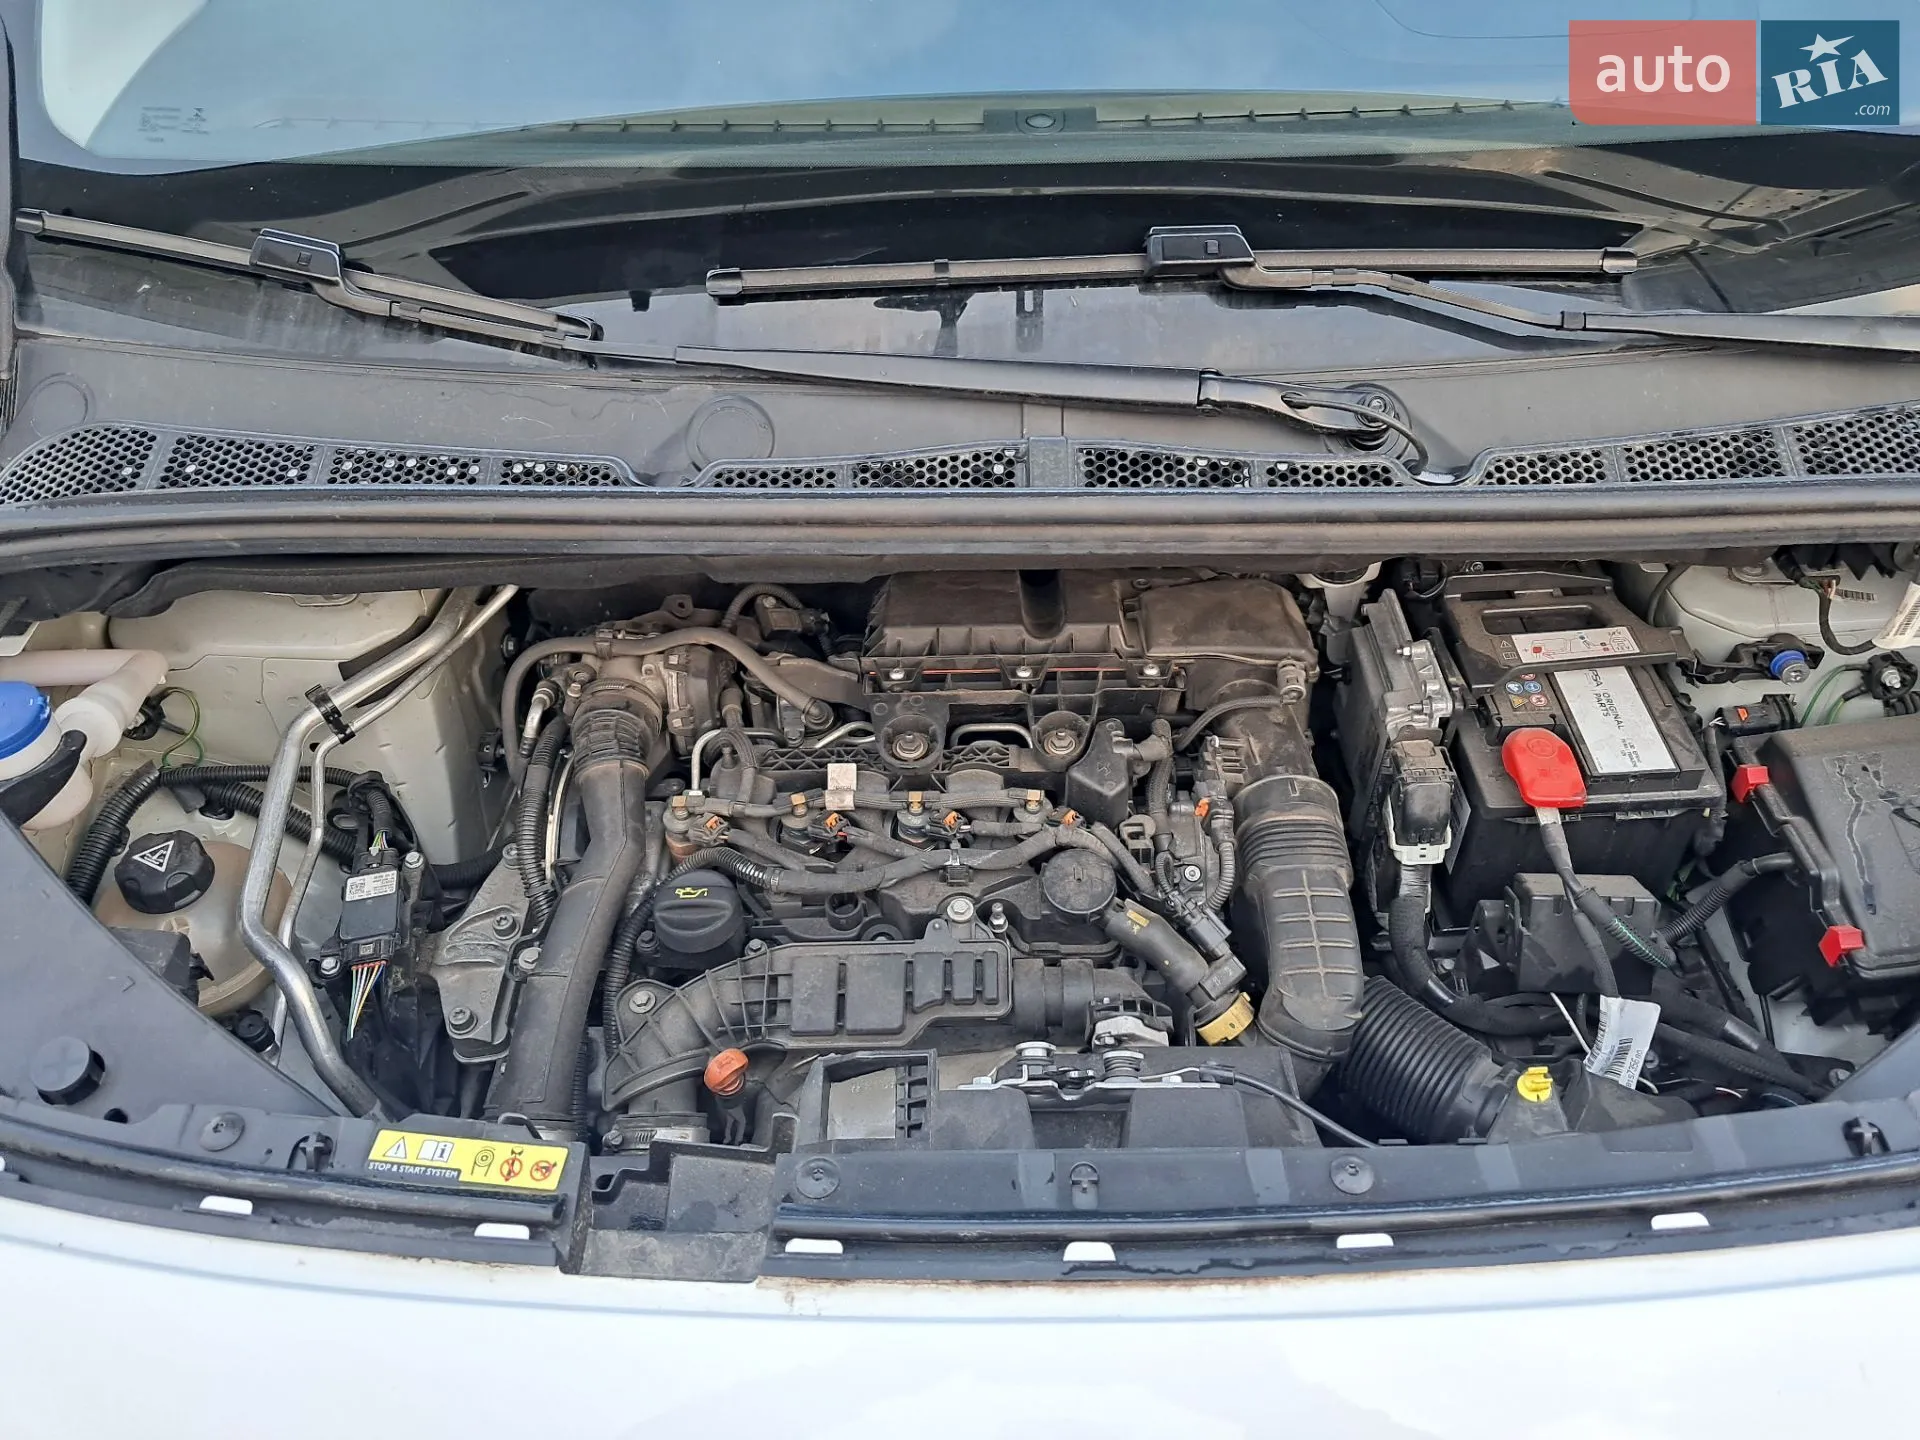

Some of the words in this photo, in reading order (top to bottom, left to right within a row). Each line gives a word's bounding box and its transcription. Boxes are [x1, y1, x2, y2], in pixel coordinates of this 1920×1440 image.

[1588, 669, 1603, 687] PSA
[1602, 692, 1624, 730] ORIGINAL
[1593, 692, 1611, 717] PARTS
[368, 1162, 391, 1170] STOP
[399, 1165, 425, 1174] START
[426, 1168, 458, 1178] SYSTEM
